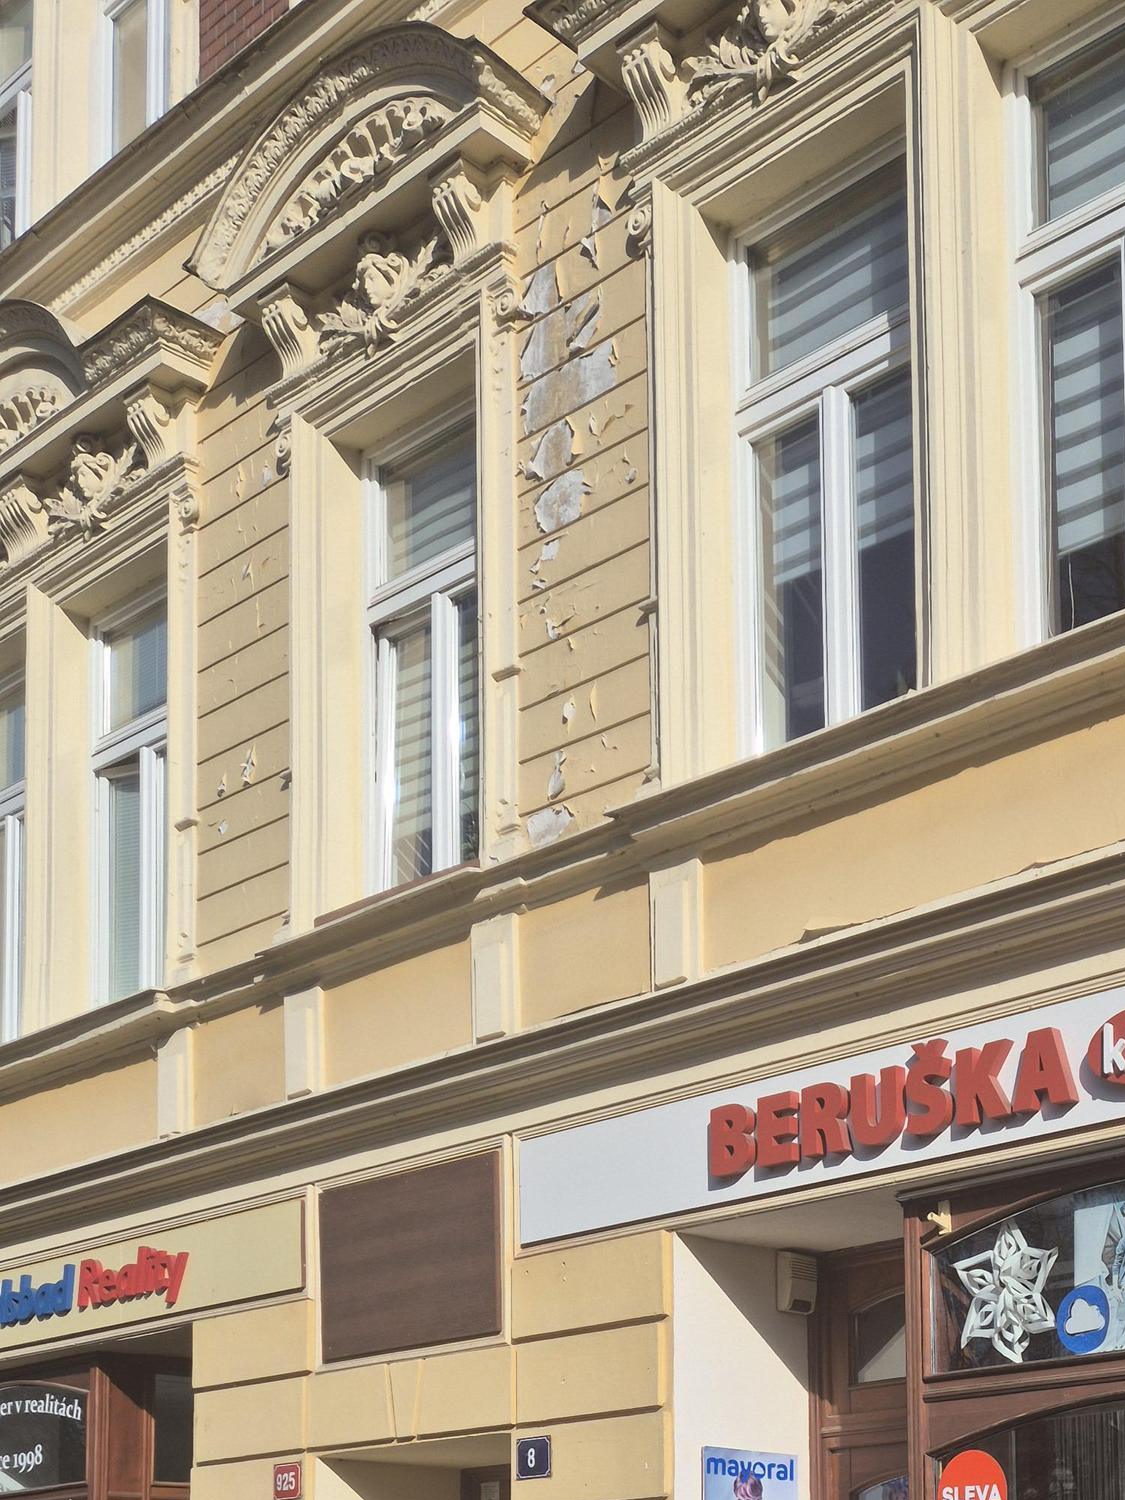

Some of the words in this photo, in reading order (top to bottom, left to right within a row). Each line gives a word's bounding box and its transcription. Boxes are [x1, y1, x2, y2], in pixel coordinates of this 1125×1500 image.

[707, 1026, 1080, 1180] BERUŠKA
[77, 1246, 190, 1309] Reality
[15, 1400, 22, 1414] v
[24, 1393, 82, 1420] realitách
[13, 1444, 43, 1473] 1998
[526, 1447, 536, 1469] 8
[706, 1457, 795, 1484] mayoral
[275, 1471, 296, 1492] 925
